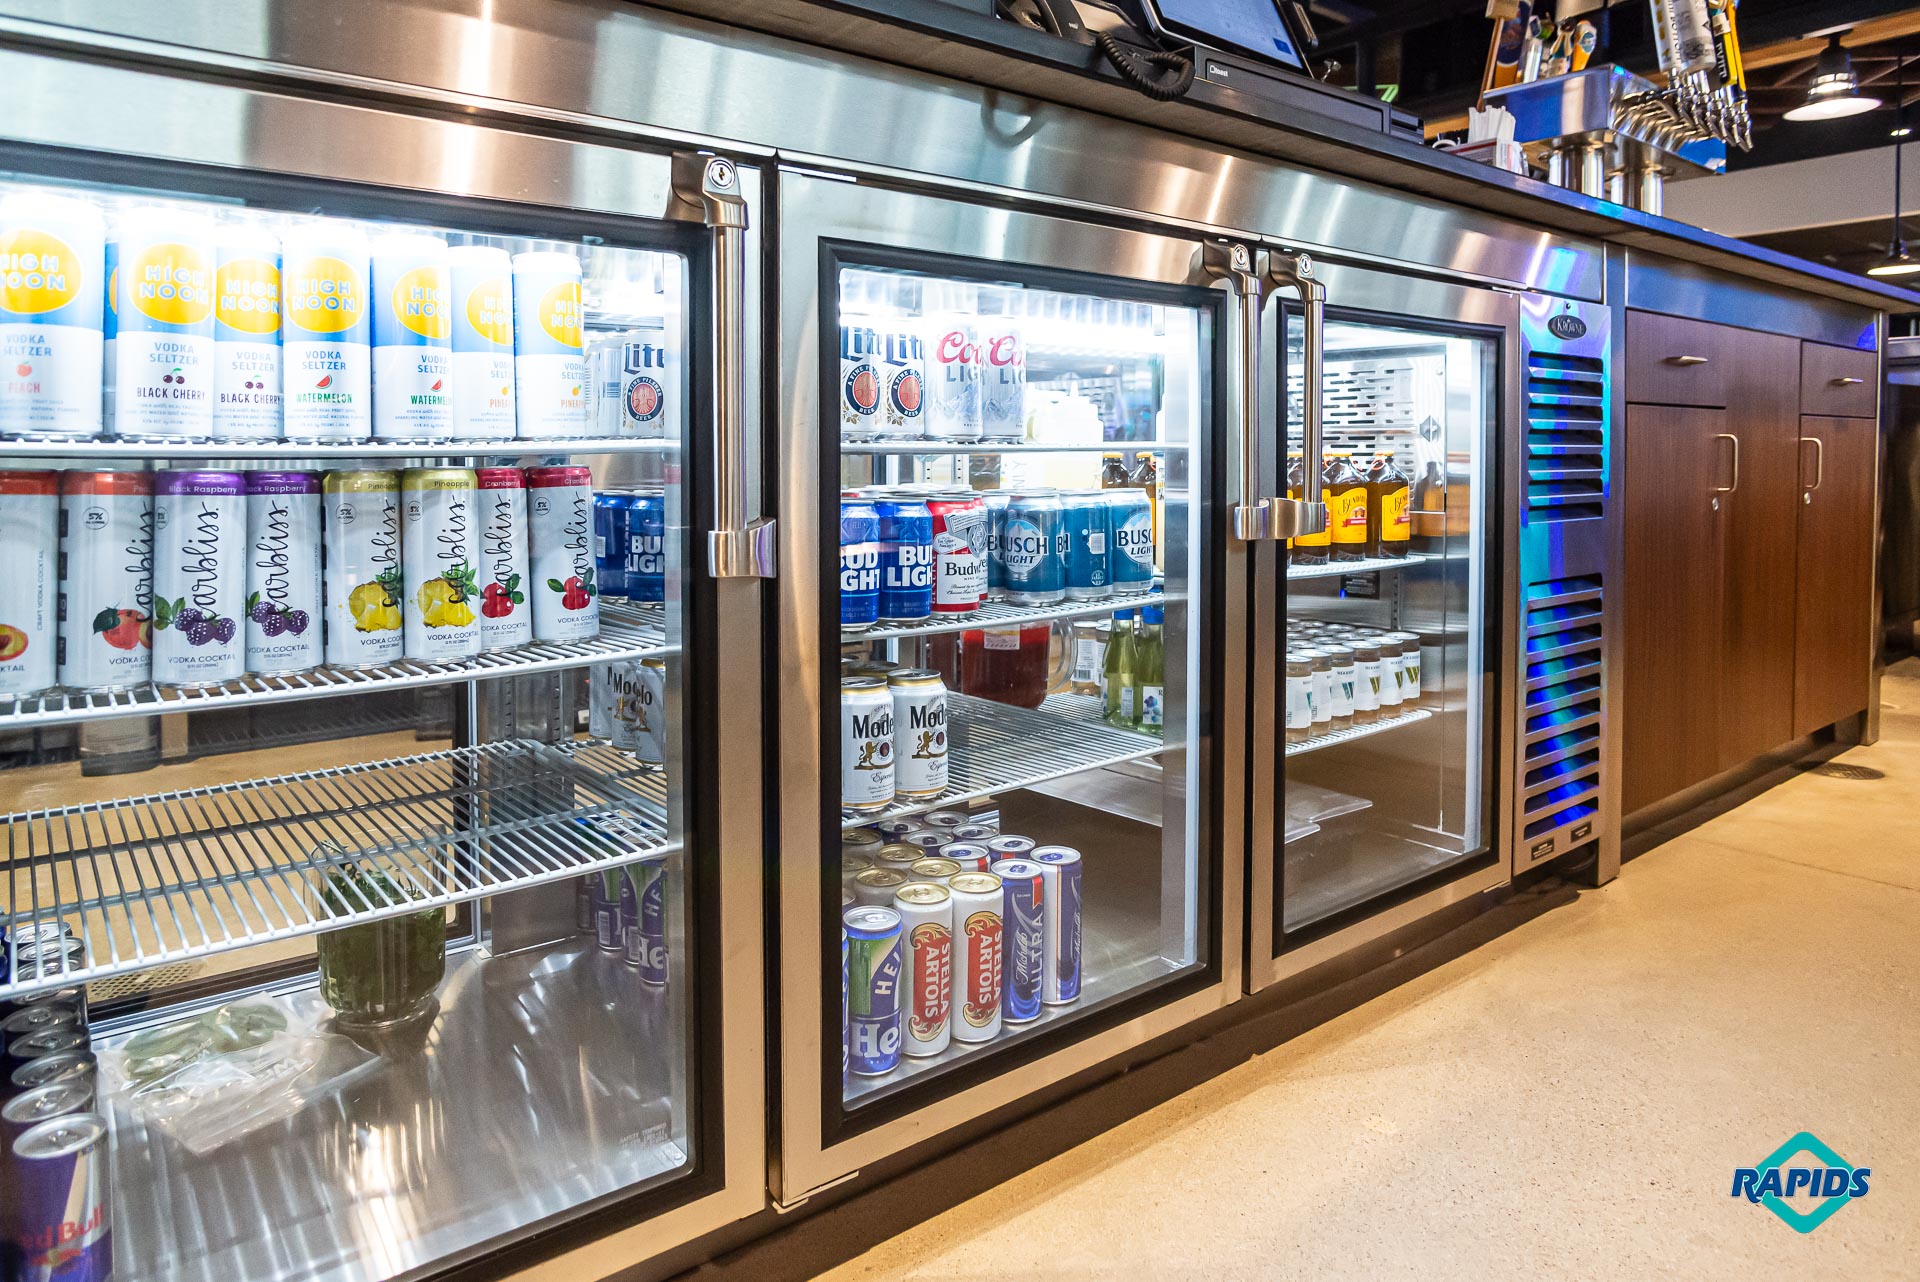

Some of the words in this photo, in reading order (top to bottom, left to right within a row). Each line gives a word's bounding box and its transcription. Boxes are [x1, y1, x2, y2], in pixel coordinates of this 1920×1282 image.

[1215, 67, 1229, 78] toast
[144, 265, 206, 286] HIGH
[226, 279, 278, 298] HIGH
[297, 279, 351, 295] HIGH
[139, 283, 209, 305] NOON
[221, 296, 281, 314] NOON
[291, 295, 356, 313] NOON
[6, 334, 46, 345] VODKA
[3, 345, 52, 357] SELTZER
[154, 342, 194, 354] VODKA
[149, 353, 199, 366] SELTZER
[236, 351, 272, 361] VODKA
[305, 350, 342, 360] VODKA
[231, 361, 276, 372] SELTZER
[301, 360, 347, 371] SELTZER
[8, 382, 41, 394] PEACH
[136, 387, 169, 399] BLACK
[172, 388, 206, 401] CHERRY
[220, 392, 250, 404] BLACK
[295, 392, 353, 404] WATERMELON
[168, 485, 191, 493] Black
[193, 486, 238, 495] Raspberry
[264, 485, 306, 493] Raspberry
[434, 480, 470, 488] Pineapple
[409, 505, 420, 513] 5%
[537, 501, 547, 509] 5%
[88, 512, 103, 520] 5%
[339, 508, 352, 516] 5%
[631, 535, 665, 555] BU
[898, 544, 933, 566] BU
[361, 637, 386, 646] VODKA
[427, 632, 453, 641] VODKA
[272, 643, 310, 653] COCKTAIL
[109, 656, 139, 665] VODKA
[168, 656, 197, 664] VODKA
[198, 654, 236, 664] COCKTAIL
[1031, 911, 1043, 993] ULTRA
[979, 934, 992, 1005] ARTOIS
[924, 946, 940, 1019] ARTOIS
[850, 1021, 901, 1058] He
[57, 1202, 105, 1243] Bull
